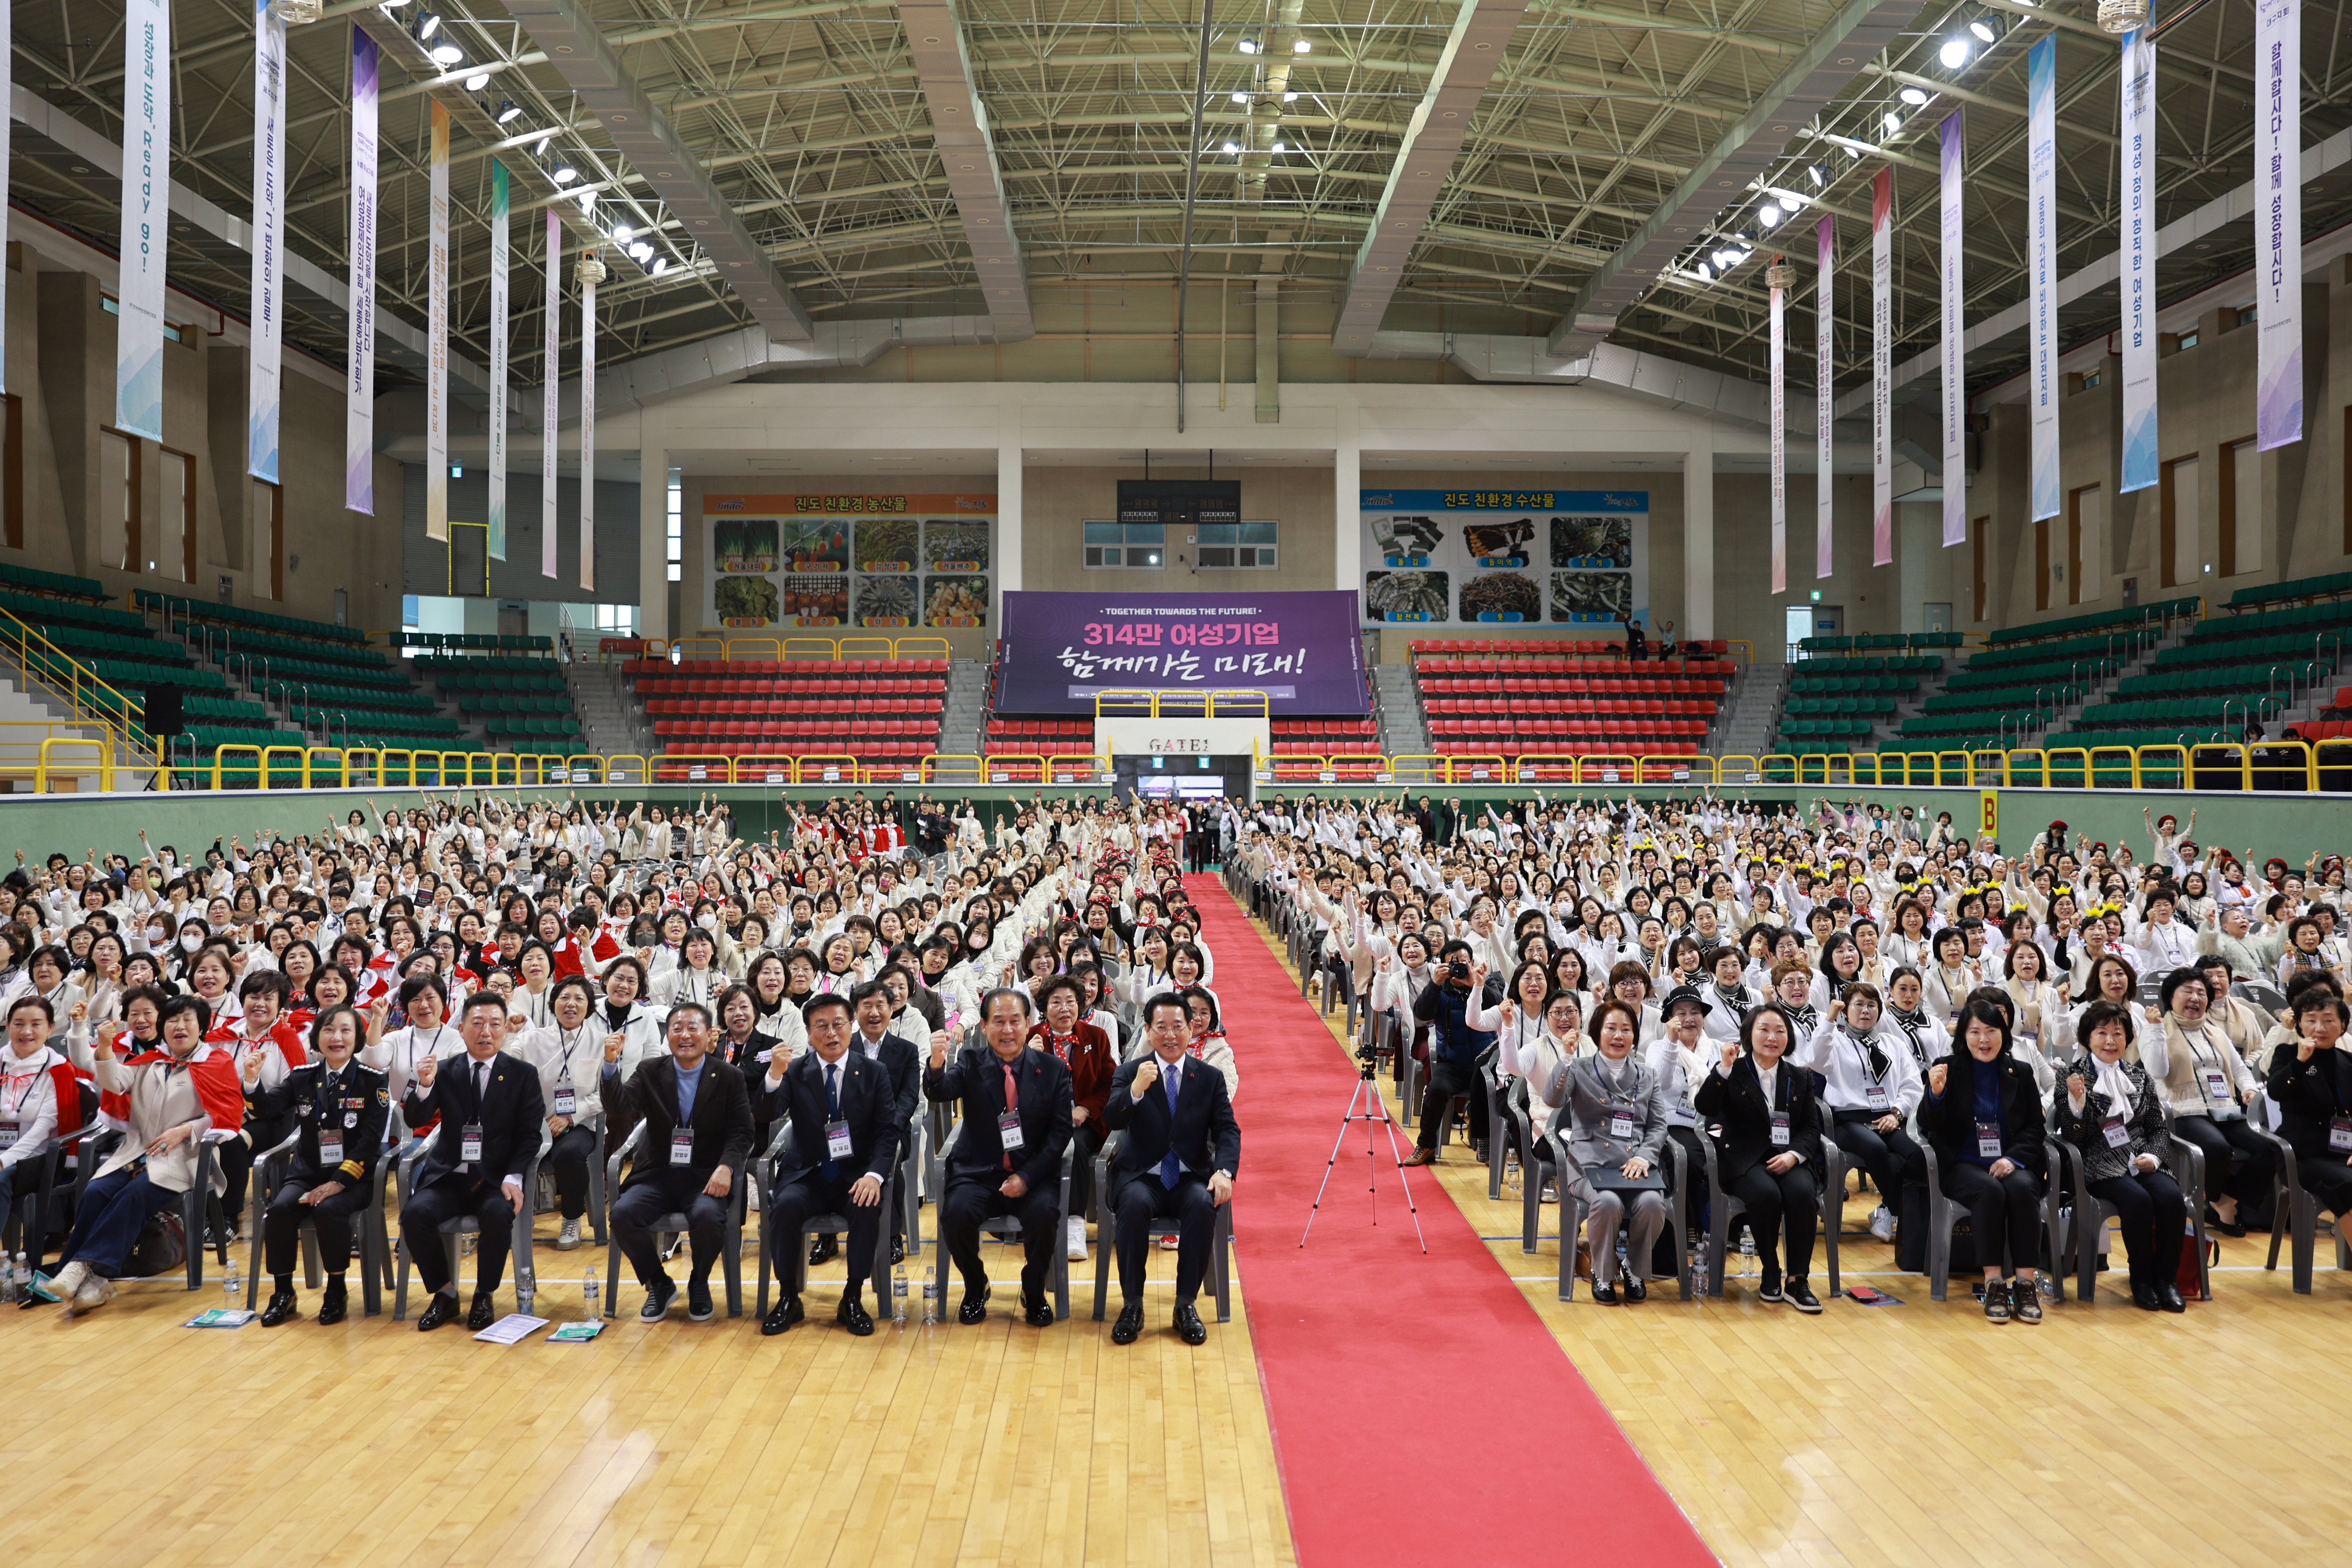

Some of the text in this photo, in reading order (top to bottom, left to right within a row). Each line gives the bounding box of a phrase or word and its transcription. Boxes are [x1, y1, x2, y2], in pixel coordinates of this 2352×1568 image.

[2267, 6, 2289, 28] 대구지회
[263, 85, 278, 102] 제주지회
[2129, 104, 2147, 120] 광주지회
[141, 20, 156, 272] 성장과 도약, Ready go!
[2036, 169, 2049, 183] 대전지회
[2271, 40, 2282, 303] 함께합시다! 함께 성장합시다!
[266, 171, 274, 211] 도약,
[440, 247, 445, 277] 함께
[358, 273, 365, 294] 힘,
[440, 280, 445, 309] 가는
[2133, 278, 2141, 348] 여성기업
[355, 295, 363, 395] 세종충남지회가
[1820, 335, 1825, 346] 더
[1826, 332, 1830, 343] 더
[1882, 352, 1887, 376] 함께
[715, 503, 741, 511] Jindo
[795, 496, 906, 512] 진도 친환경 농산물
[973, 501, 990, 512] 진도
[1362, 497, 1388, 506] Jindo
[1444, 492, 1555, 508] 진도 친환경 수산물
[1621, 498, 1639, 509] 진도
[733, 562, 761, 571] 겨울대파
[805, 562, 829, 571] 구기자
[875, 562, 898, 570] 검정쌀
[942, 562, 971, 570] 겨울배추
[1488, 558, 1513, 567] 돌미역
[1396, 612, 1421, 621] 참전복
[1083, 623, 1279, 646] 314만 여성기업
[1056, 646, 1307, 681] 함께가는 미래!
[1984, 798, 1995, 830] B
[2109, 1133, 2125, 1141] 이민재
